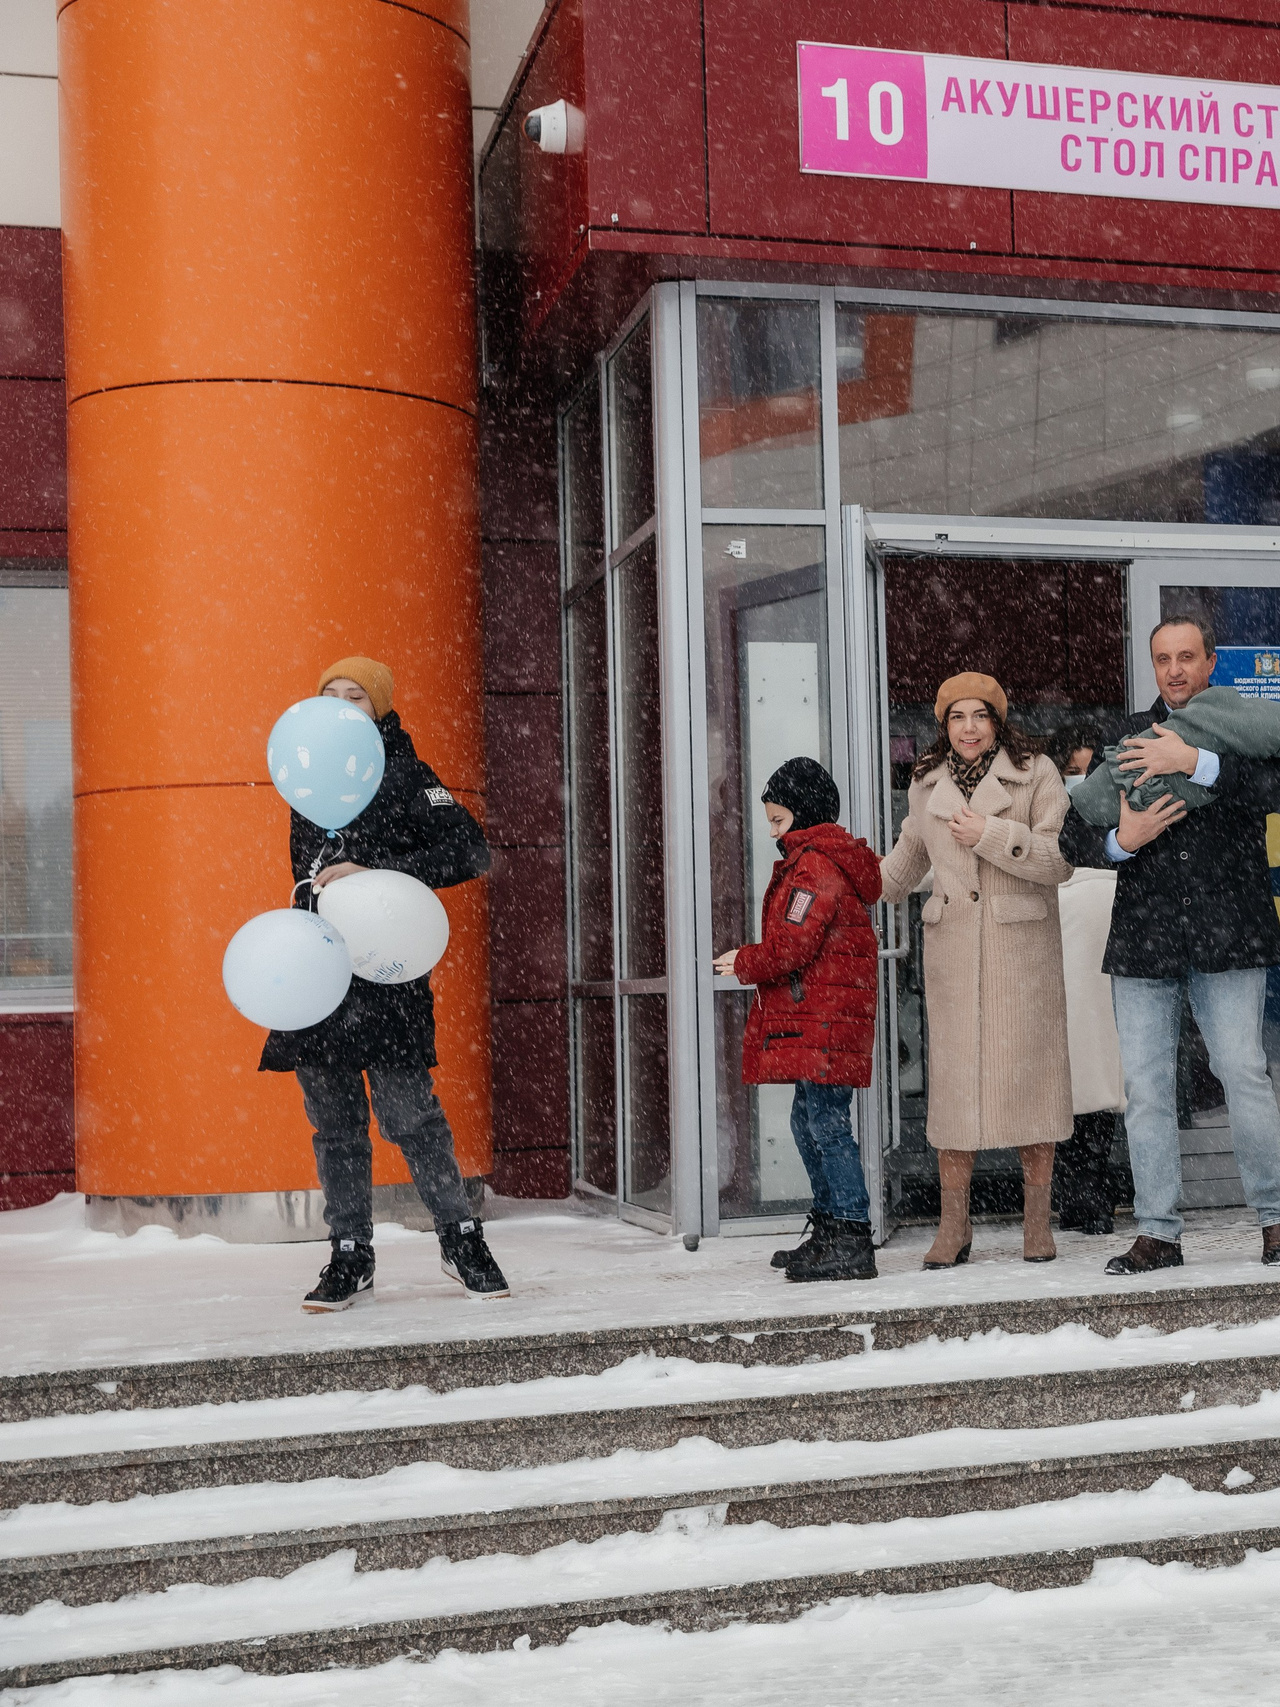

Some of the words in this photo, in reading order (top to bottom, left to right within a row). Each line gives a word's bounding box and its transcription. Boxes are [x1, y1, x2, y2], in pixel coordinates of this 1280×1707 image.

[821, 78, 904, 146] 10
[941, 76, 1220, 135] АКУШЕРСКИЙ
[1060, 134, 1164, 178] СТОЛ
[1234, 677, 1267, 685] БЮДЖЕТНОЕ
